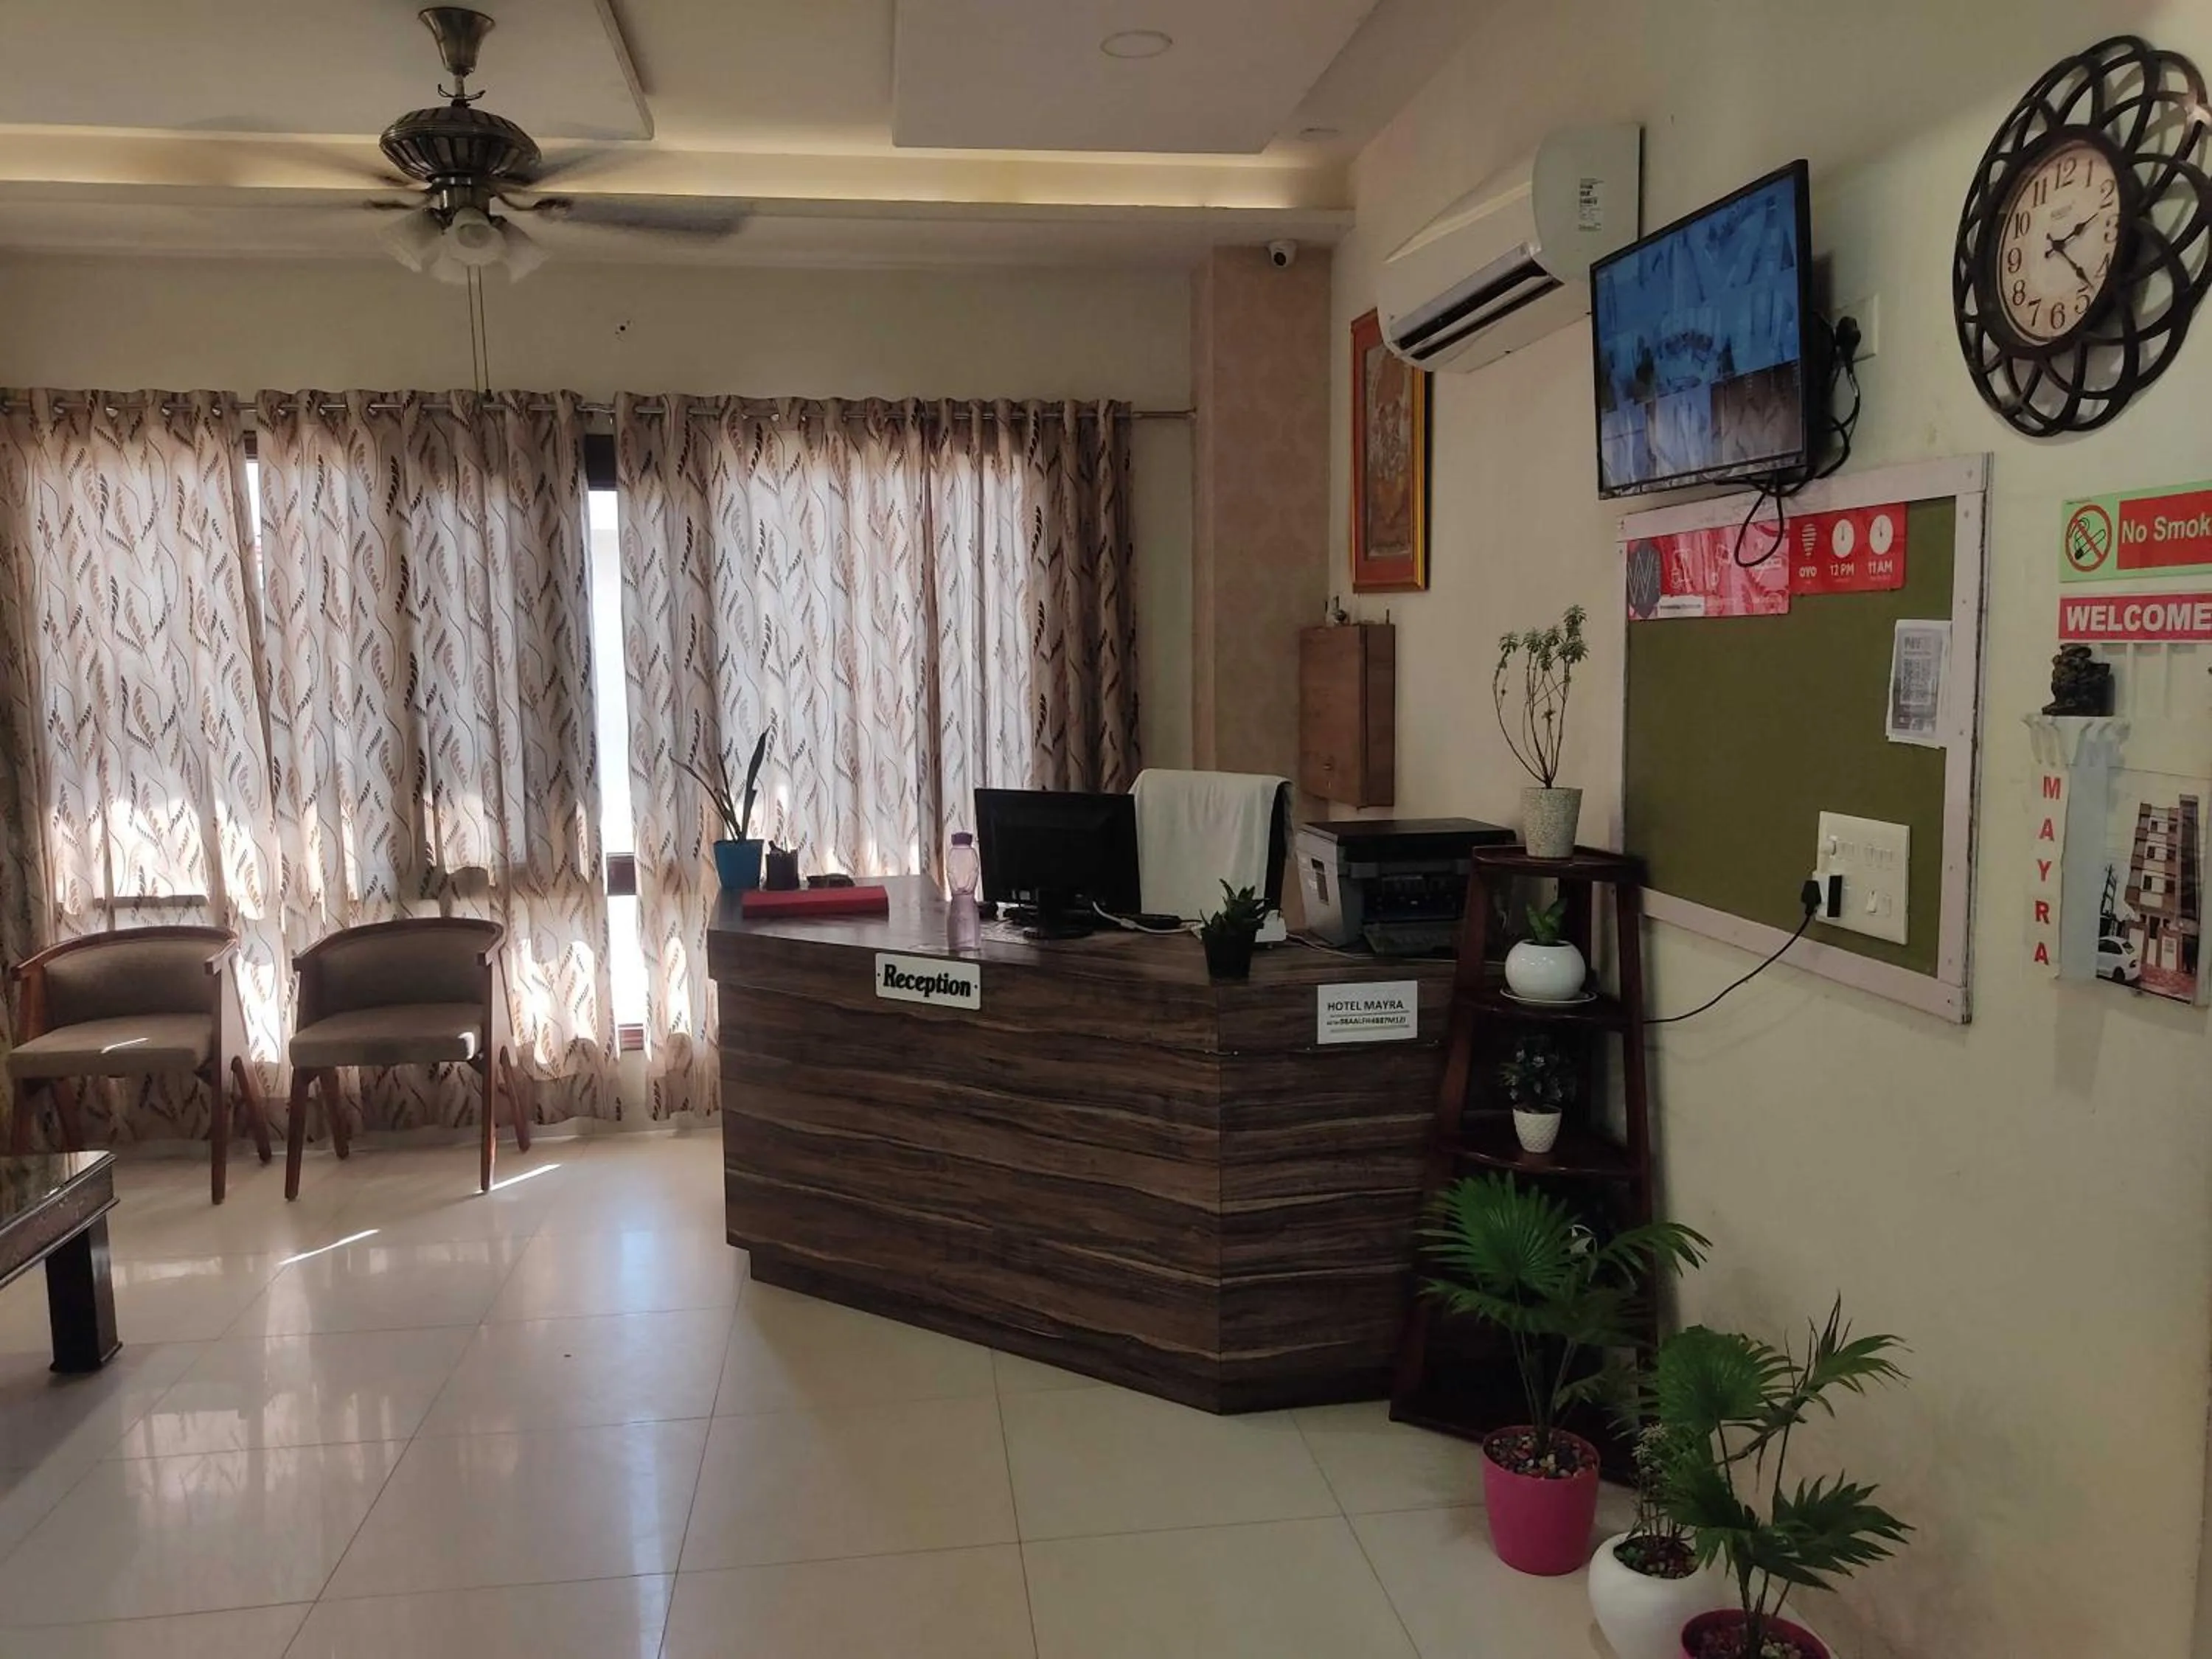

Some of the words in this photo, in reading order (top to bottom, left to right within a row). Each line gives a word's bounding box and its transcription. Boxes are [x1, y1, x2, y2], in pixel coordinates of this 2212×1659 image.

[2054, 156, 2076, 190] 12
[2086, 159, 2094, 188] 1
[2032, 177, 2048, 209] 11
[2100, 178, 2115, 209] 2
[2013, 210, 2031, 240] 10
[2104, 214, 2119, 243] 3
[2008, 247, 2023, 274] 9
[2094, 252, 2112, 278] 4
[2012, 279, 2026, 307] 8
[2074, 285, 2091, 314] 5
[2028, 298, 2042, 327] 7
[2050, 302, 2065, 330] 6
[2121, 519, 2147, 543] No
[2153, 512, 2212, 542] Smok
[1798, 566, 1818, 578] OYO
[1840, 563, 1854, 577] PM
[1877, 560, 1893, 574] AM
[2066, 602, 2212, 632] WELCOME
[883, 963, 971, 998] Reception
[1328, 1001, 1362, 1012] HOTEL
[1363, 999, 1404, 1010] MAYRA
